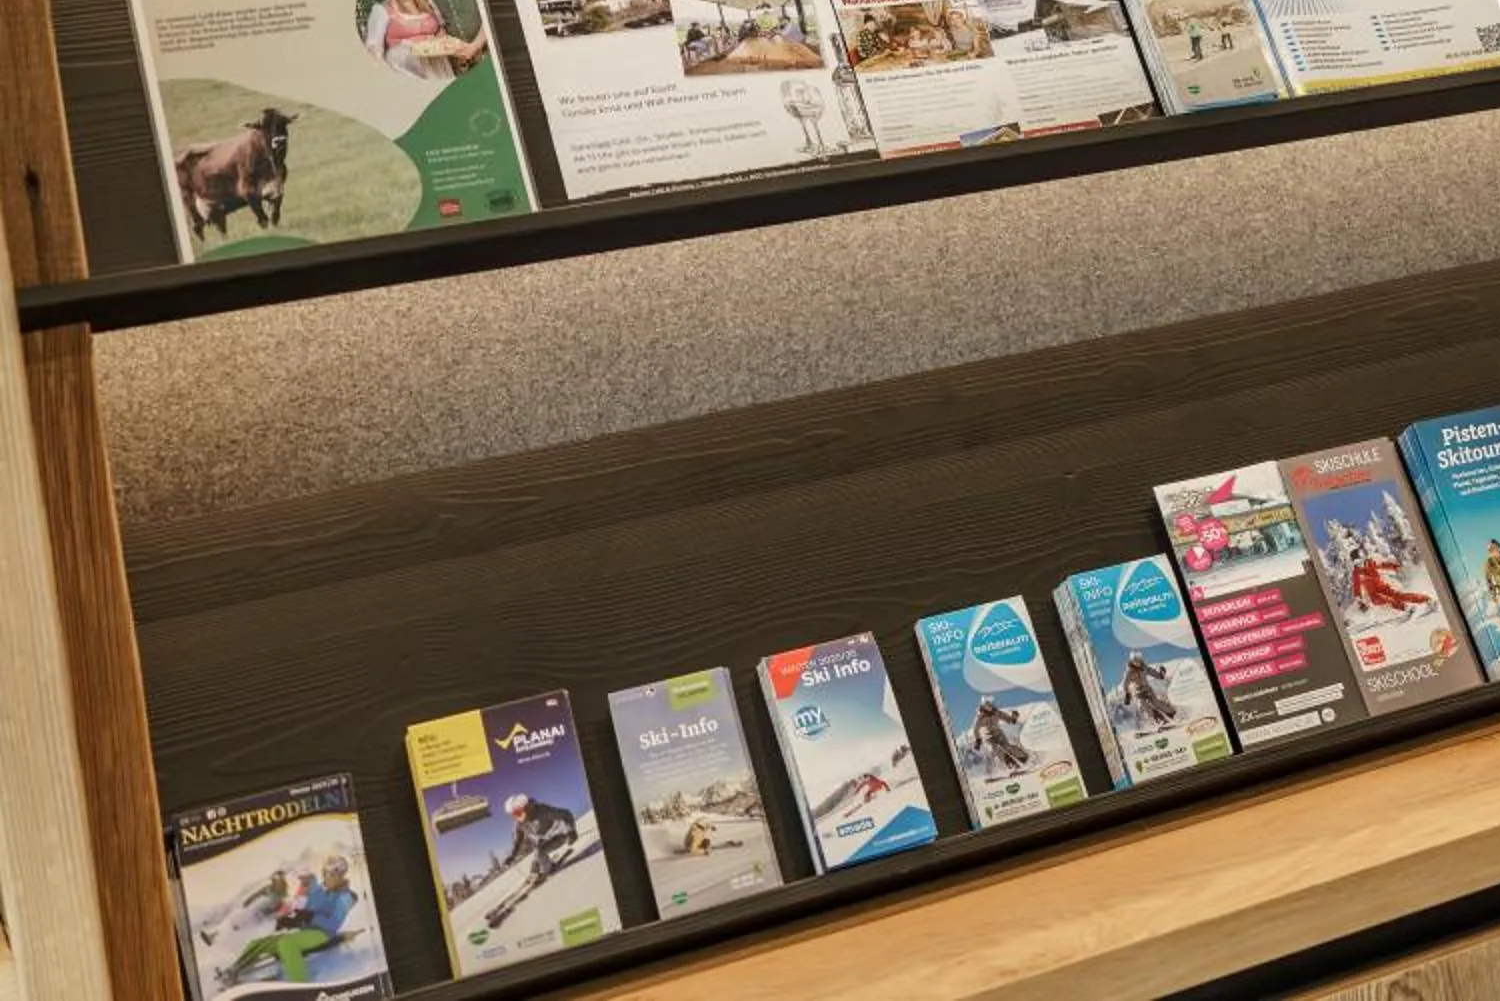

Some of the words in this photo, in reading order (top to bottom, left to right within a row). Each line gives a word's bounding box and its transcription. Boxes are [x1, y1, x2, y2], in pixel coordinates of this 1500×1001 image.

[802, 665, 831, 687] Ski
[833, 659, 871, 679] Info
[513, 724, 565, 746] PLANAI
[639, 715, 719, 751] Ski-Info
[180, 784, 349, 846] NACHTRODELN
